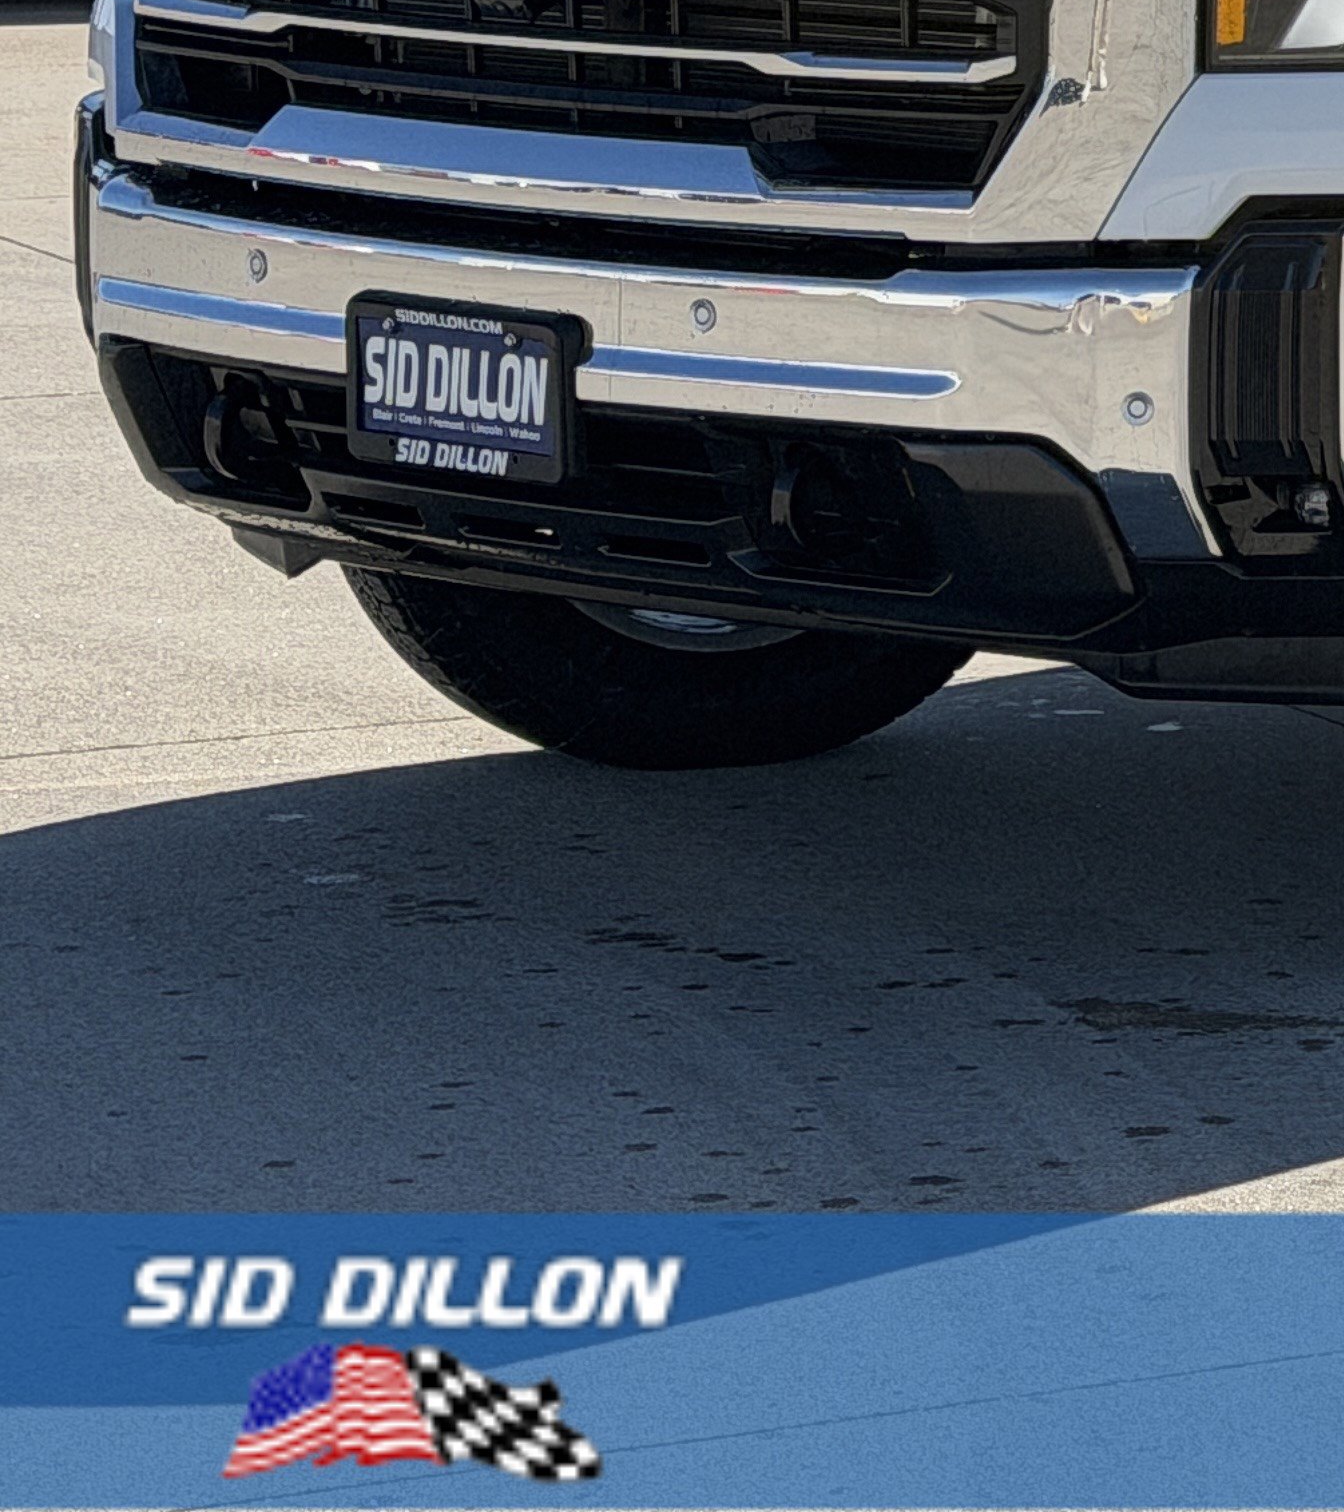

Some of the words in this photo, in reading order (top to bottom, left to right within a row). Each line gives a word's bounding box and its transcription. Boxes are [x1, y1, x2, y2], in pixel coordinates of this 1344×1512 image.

[394, 308, 504, 336] SIDDILLON.COM
[364, 336, 419, 408] SID
[425, 344, 548, 425] DILLON
[395, 437, 431, 465] SID
[434, 443, 508, 476] DILLON
